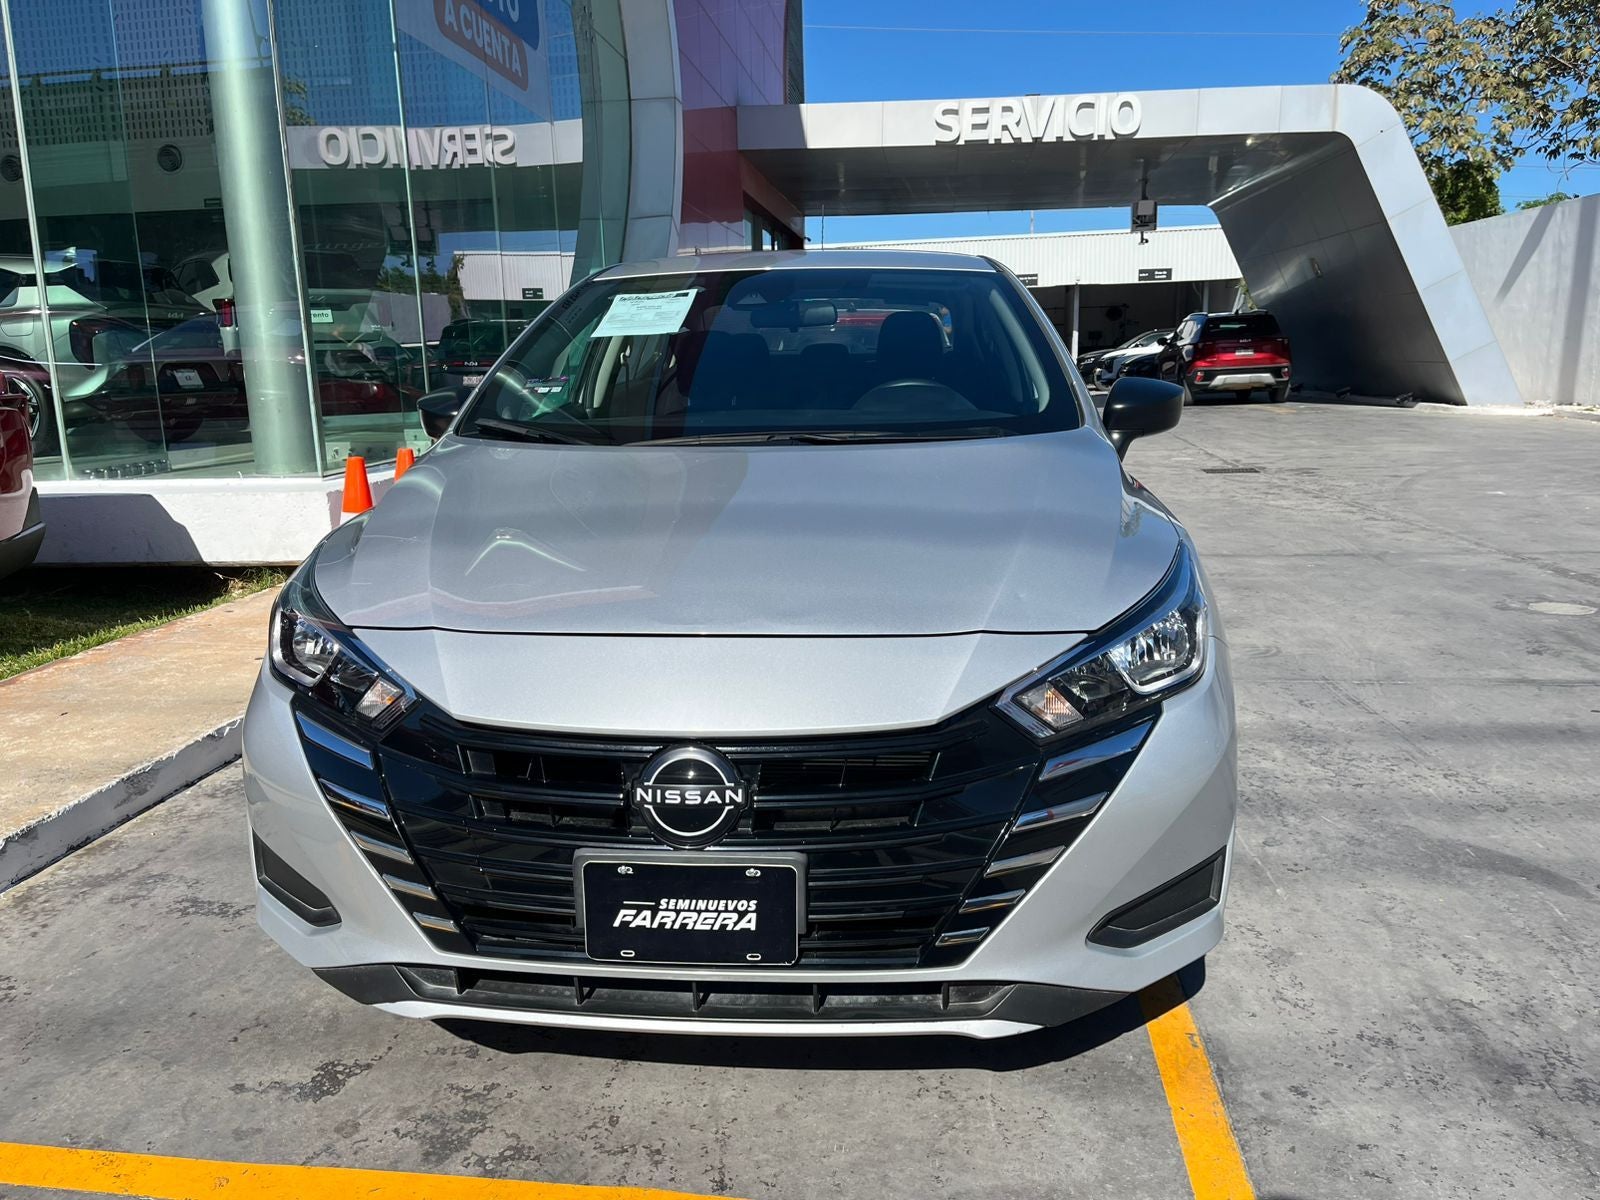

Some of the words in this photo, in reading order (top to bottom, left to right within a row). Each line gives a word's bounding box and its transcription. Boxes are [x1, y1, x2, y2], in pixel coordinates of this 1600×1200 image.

[444, 0, 458, 32] A
[460, 4, 522, 78] CUENTA
[934, 93, 1142, 143] SERVICIO
[636, 787, 743, 805] NISSAN
[658, 898, 758, 912] SEMINUEVOS
[612, 908, 758, 932] FARRERA
